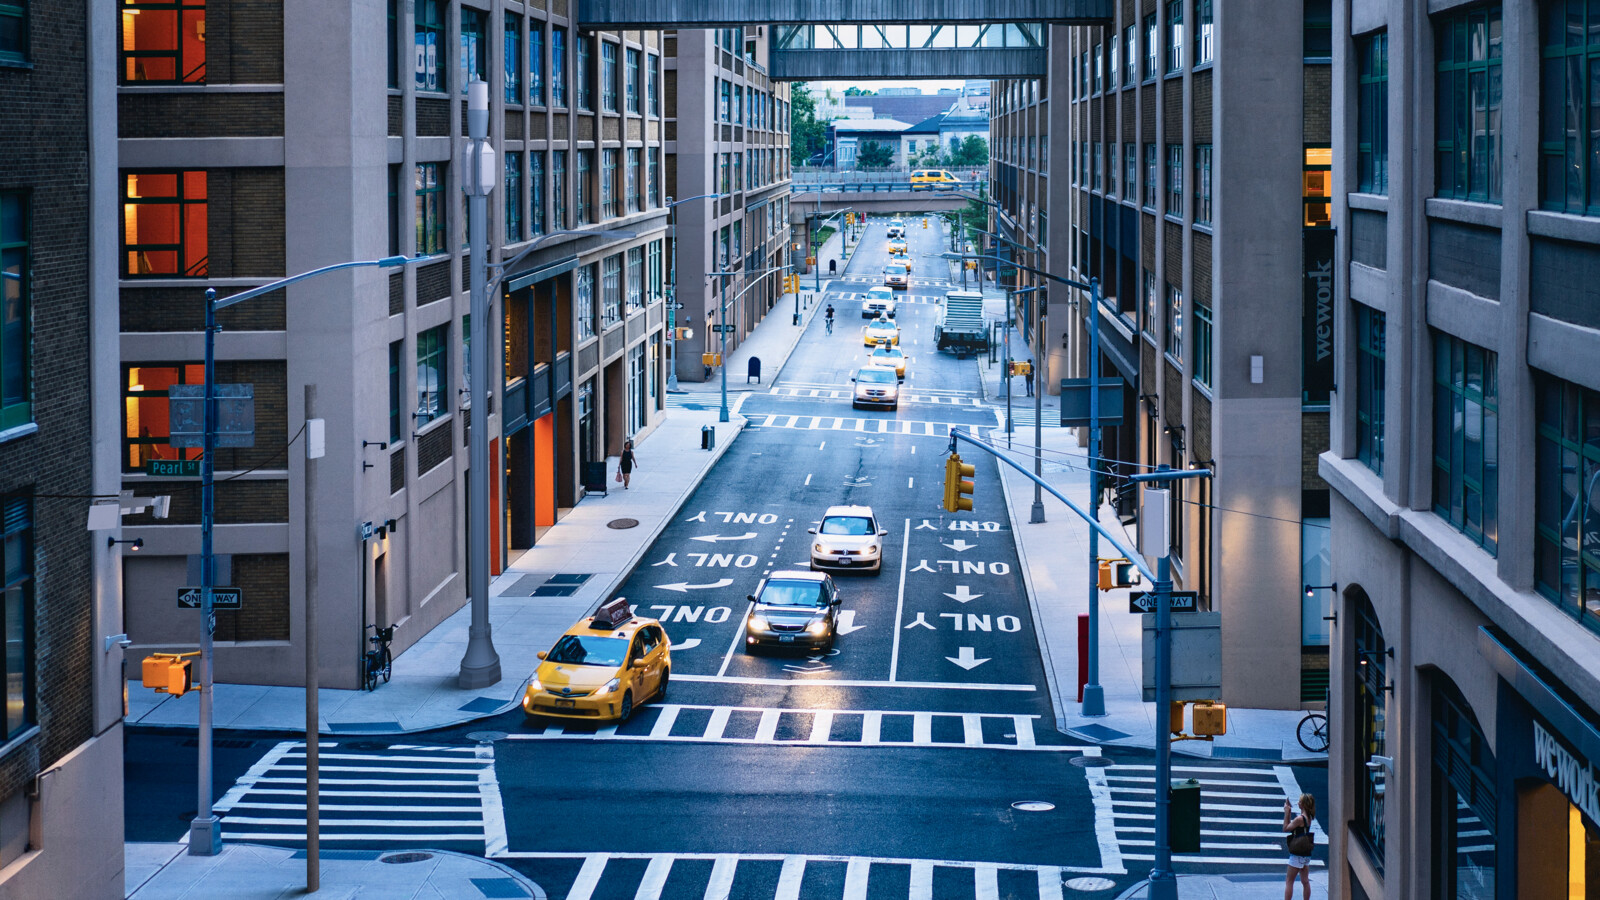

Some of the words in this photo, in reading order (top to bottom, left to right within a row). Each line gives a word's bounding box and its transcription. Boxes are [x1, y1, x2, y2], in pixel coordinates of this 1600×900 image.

[1307, 258, 1332, 362] wework
[153, 461, 183, 474] Pearl
[685, 511, 778, 525] ONLY
[651, 552, 759, 568] ONLY
[909, 559, 1010, 575] ONLY
[215, 594, 235, 602] WAY
[1139, 598, 1157, 607] ONE
[904, 611, 1022, 632] ONLY
[1532, 719, 1600, 828] wework
